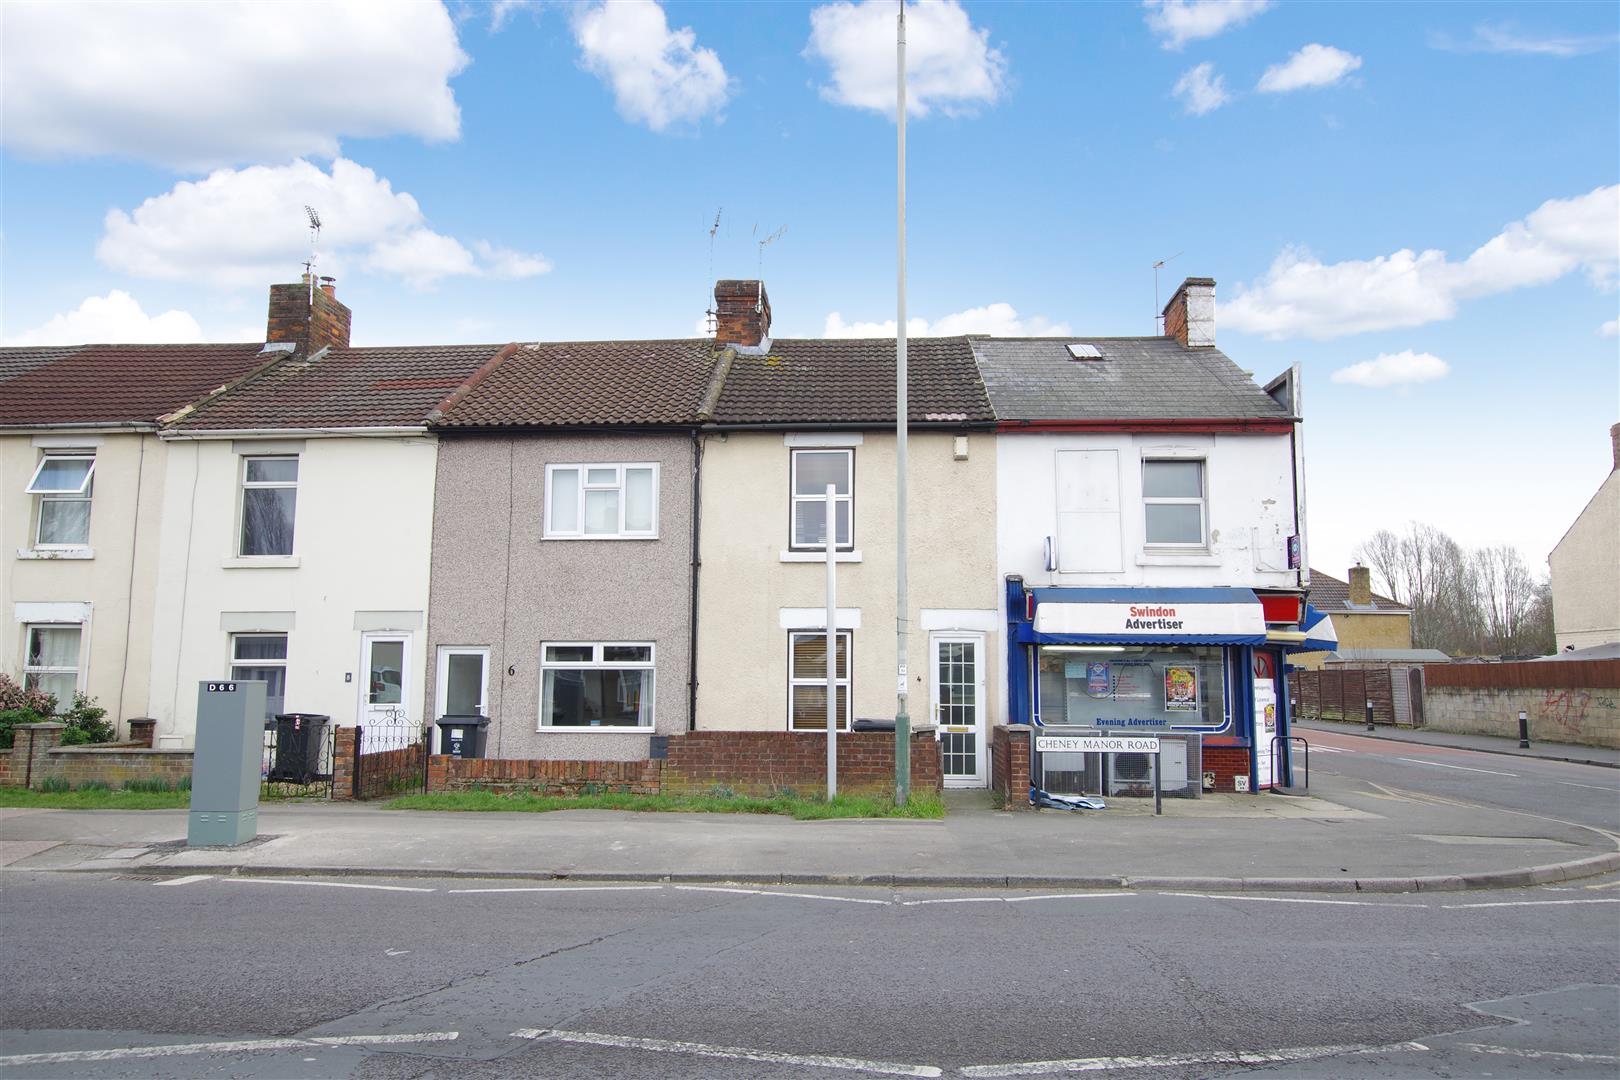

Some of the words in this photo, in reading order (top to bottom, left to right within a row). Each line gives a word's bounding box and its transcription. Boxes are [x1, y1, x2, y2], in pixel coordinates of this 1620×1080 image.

[1130, 606, 1176, 617] Swindon
[1126, 618, 1183, 629] Advertiser
[508, 664, 515, 676] 6
[1096, 717, 1126, 727] Evening
[1128, 717, 1167, 726] Advertiser
[1038, 740, 1078, 748] CHENEY
[1083, 740, 1123, 749] MANOR
[1127, 741, 1157, 749] ROAD
